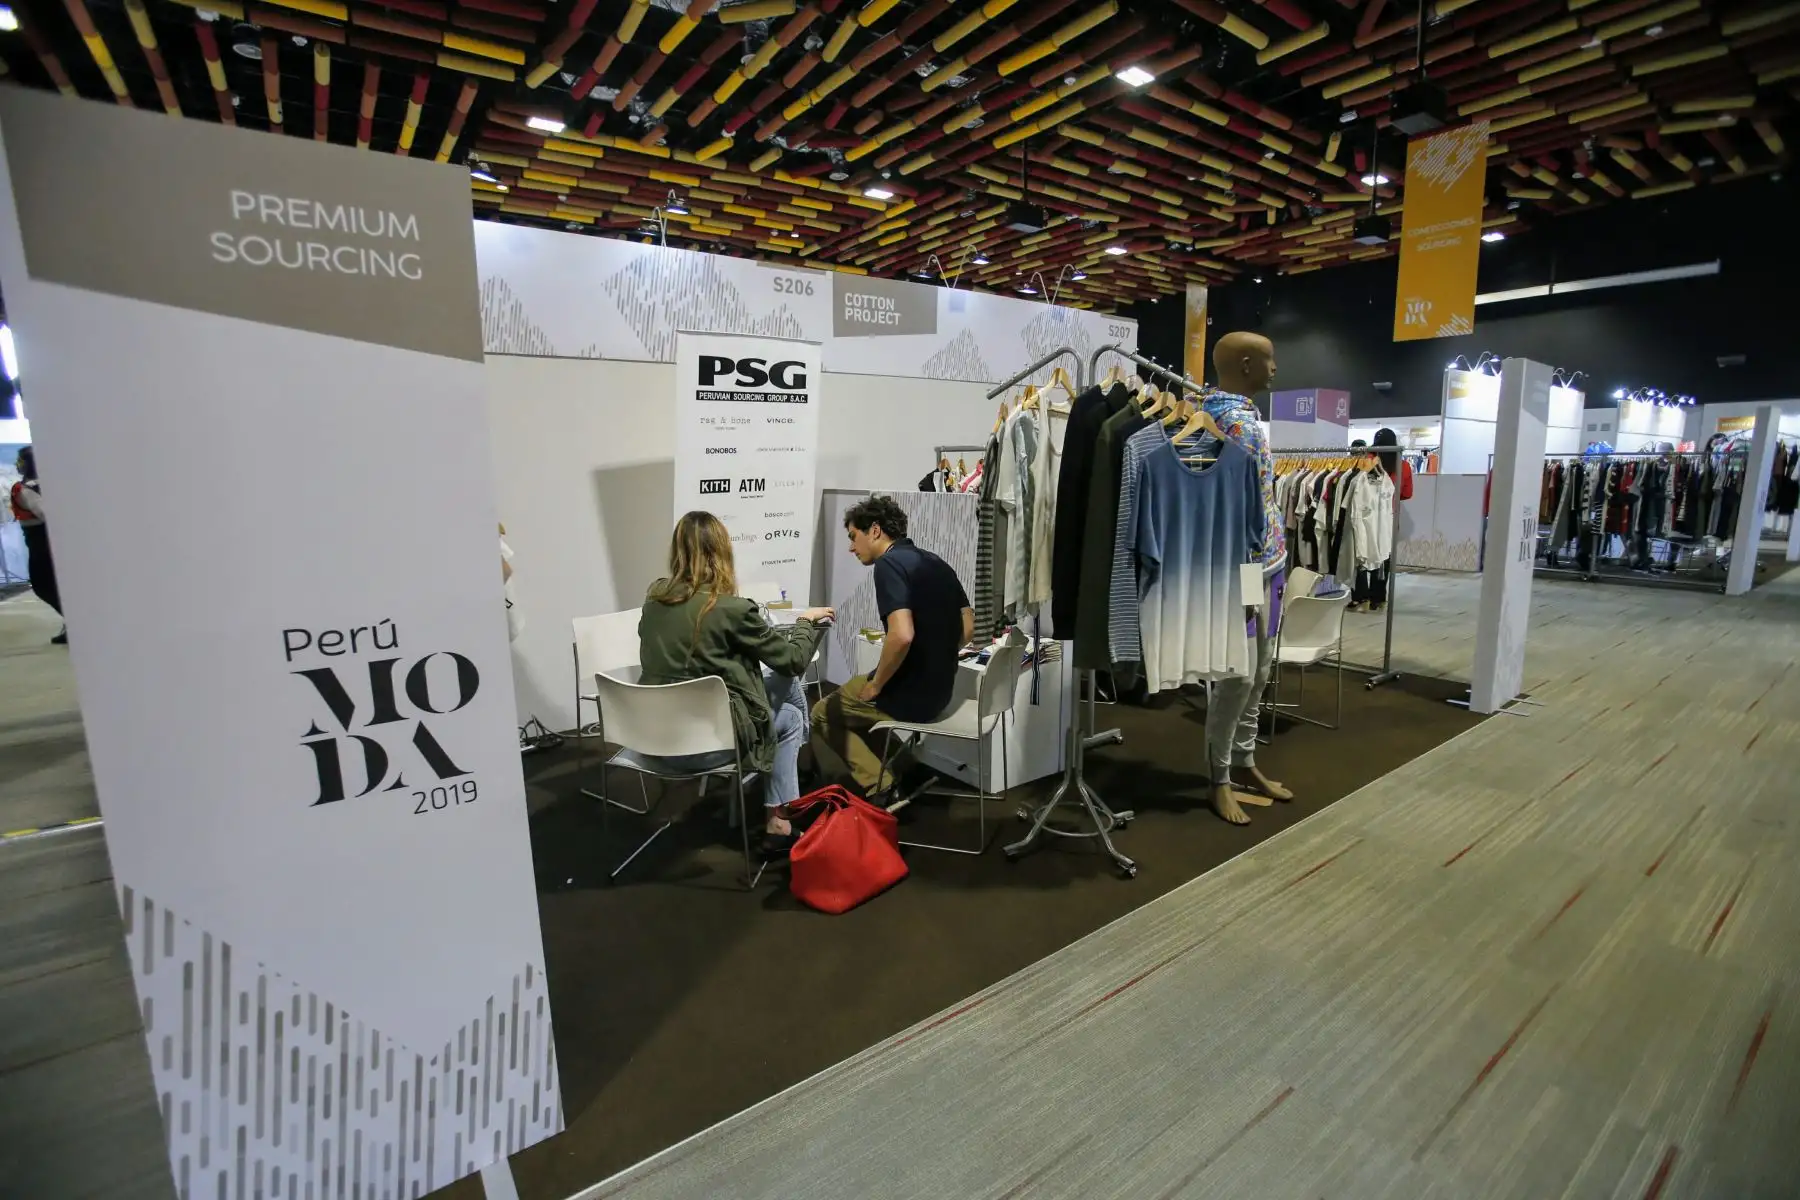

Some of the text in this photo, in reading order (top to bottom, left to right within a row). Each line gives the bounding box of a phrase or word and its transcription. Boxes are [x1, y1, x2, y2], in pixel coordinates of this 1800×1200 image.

[230, 189, 421, 242] PREMIUM
[209, 231, 423, 281] SOURCING
[773, 275, 814, 297] S206
[844, 292, 895, 311] COTTON
[844, 306, 902, 326] PROJECT
[1107, 324, 1131, 340] S207
[698, 354, 807, 390] PSG
[698, 391, 807, 403] PERUVIAN SOURCING GROUP S.A.C.
[705, 447, 737, 455] BONOBOS
[701, 480, 729, 493] KITH
[738, 478, 765, 493] ATM
[764, 529, 801, 541] ORVIS
[282, 618, 399, 662] Perú
[411, 780, 478, 815] 2019
